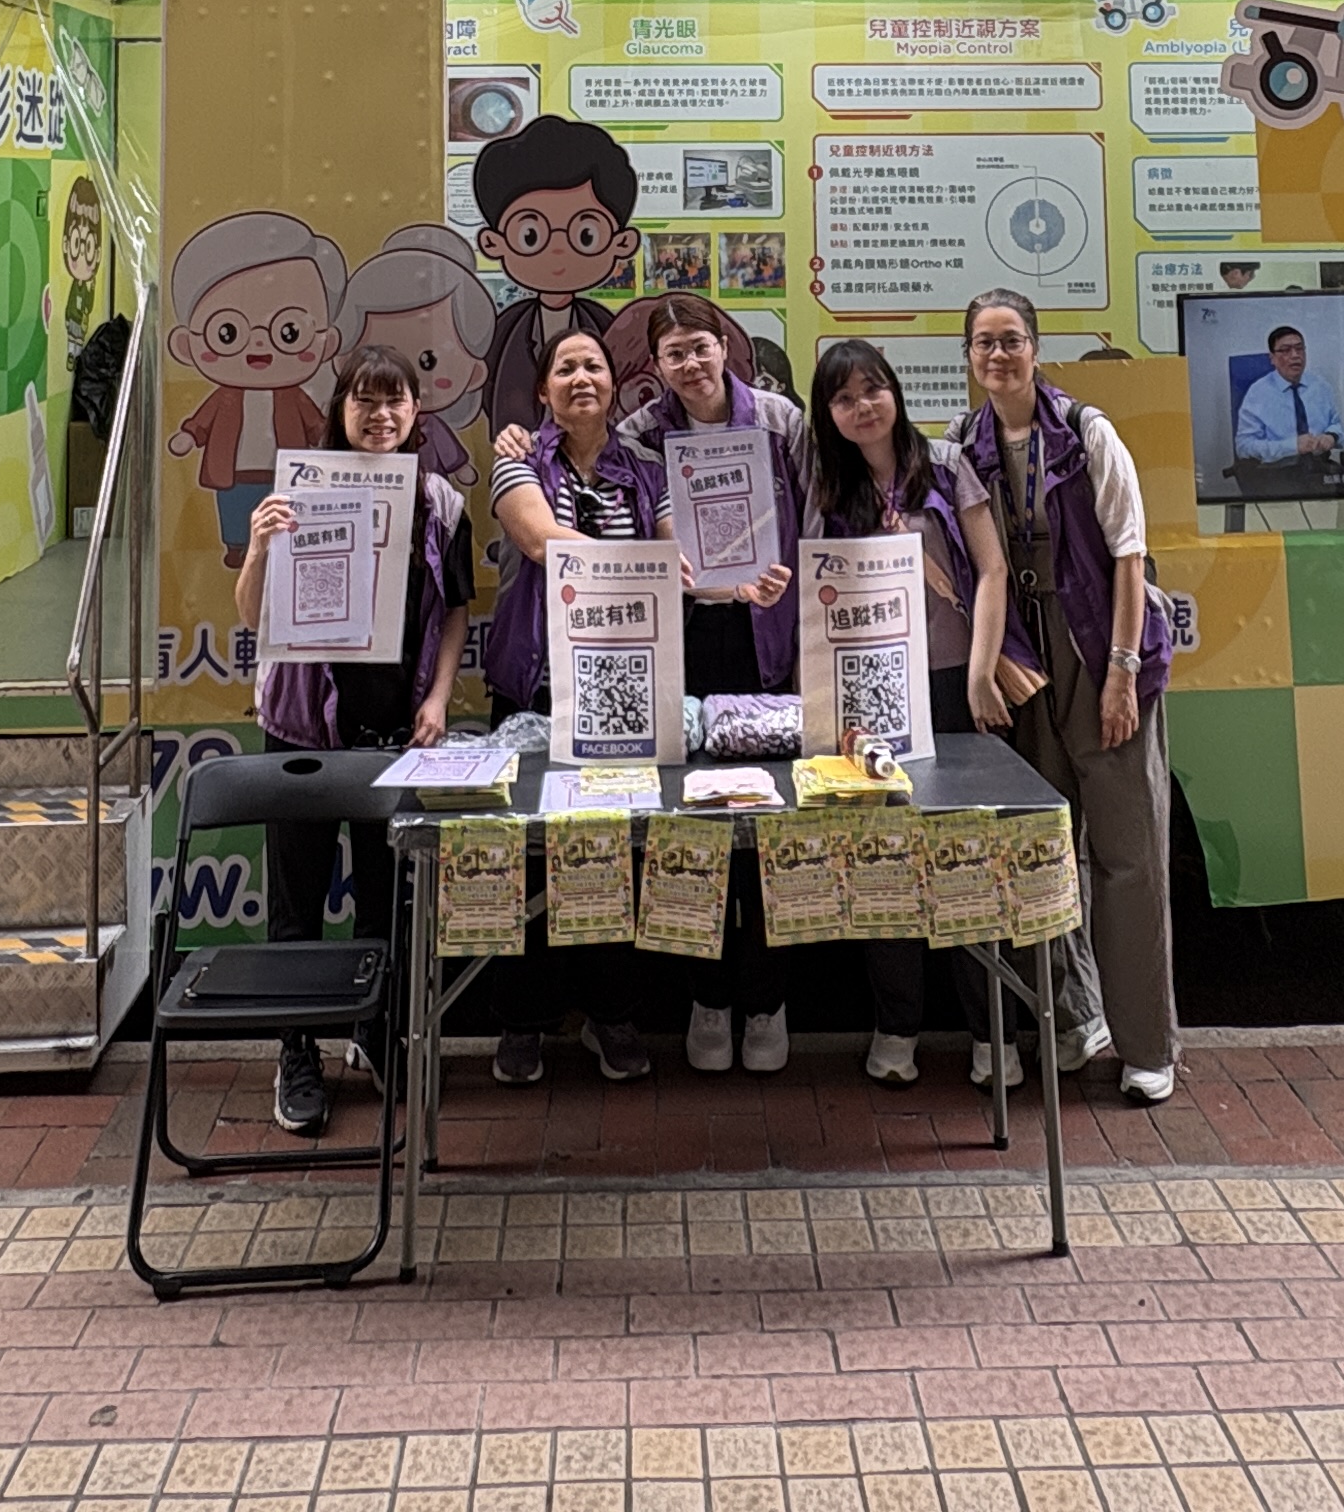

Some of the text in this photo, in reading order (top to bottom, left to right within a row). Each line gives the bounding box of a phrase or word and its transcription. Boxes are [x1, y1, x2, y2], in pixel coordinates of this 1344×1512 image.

[631, 19, 697, 39] 青光眼
[868, 18, 1041, 39] 兒童控制近視方案
[625, 41, 704, 56] Glaucoma
[896, 41, 1013, 56] Myopia Control
[1144, 40, 1227, 56] Amblyopia
[828, 143, 935, 158] 兒童控制近視方法
[1151, 262, 1203, 276] 治療方法
[689, 469, 745, 494] 追蹤有禮
[293, 527, 349, 549] 追蹤有禮
[569, 600, 648, 631] 追蹤有禮
[830, 597, 904, 632] 追蹤有禮
[581, 742, 643, 755] FACEBOOK
